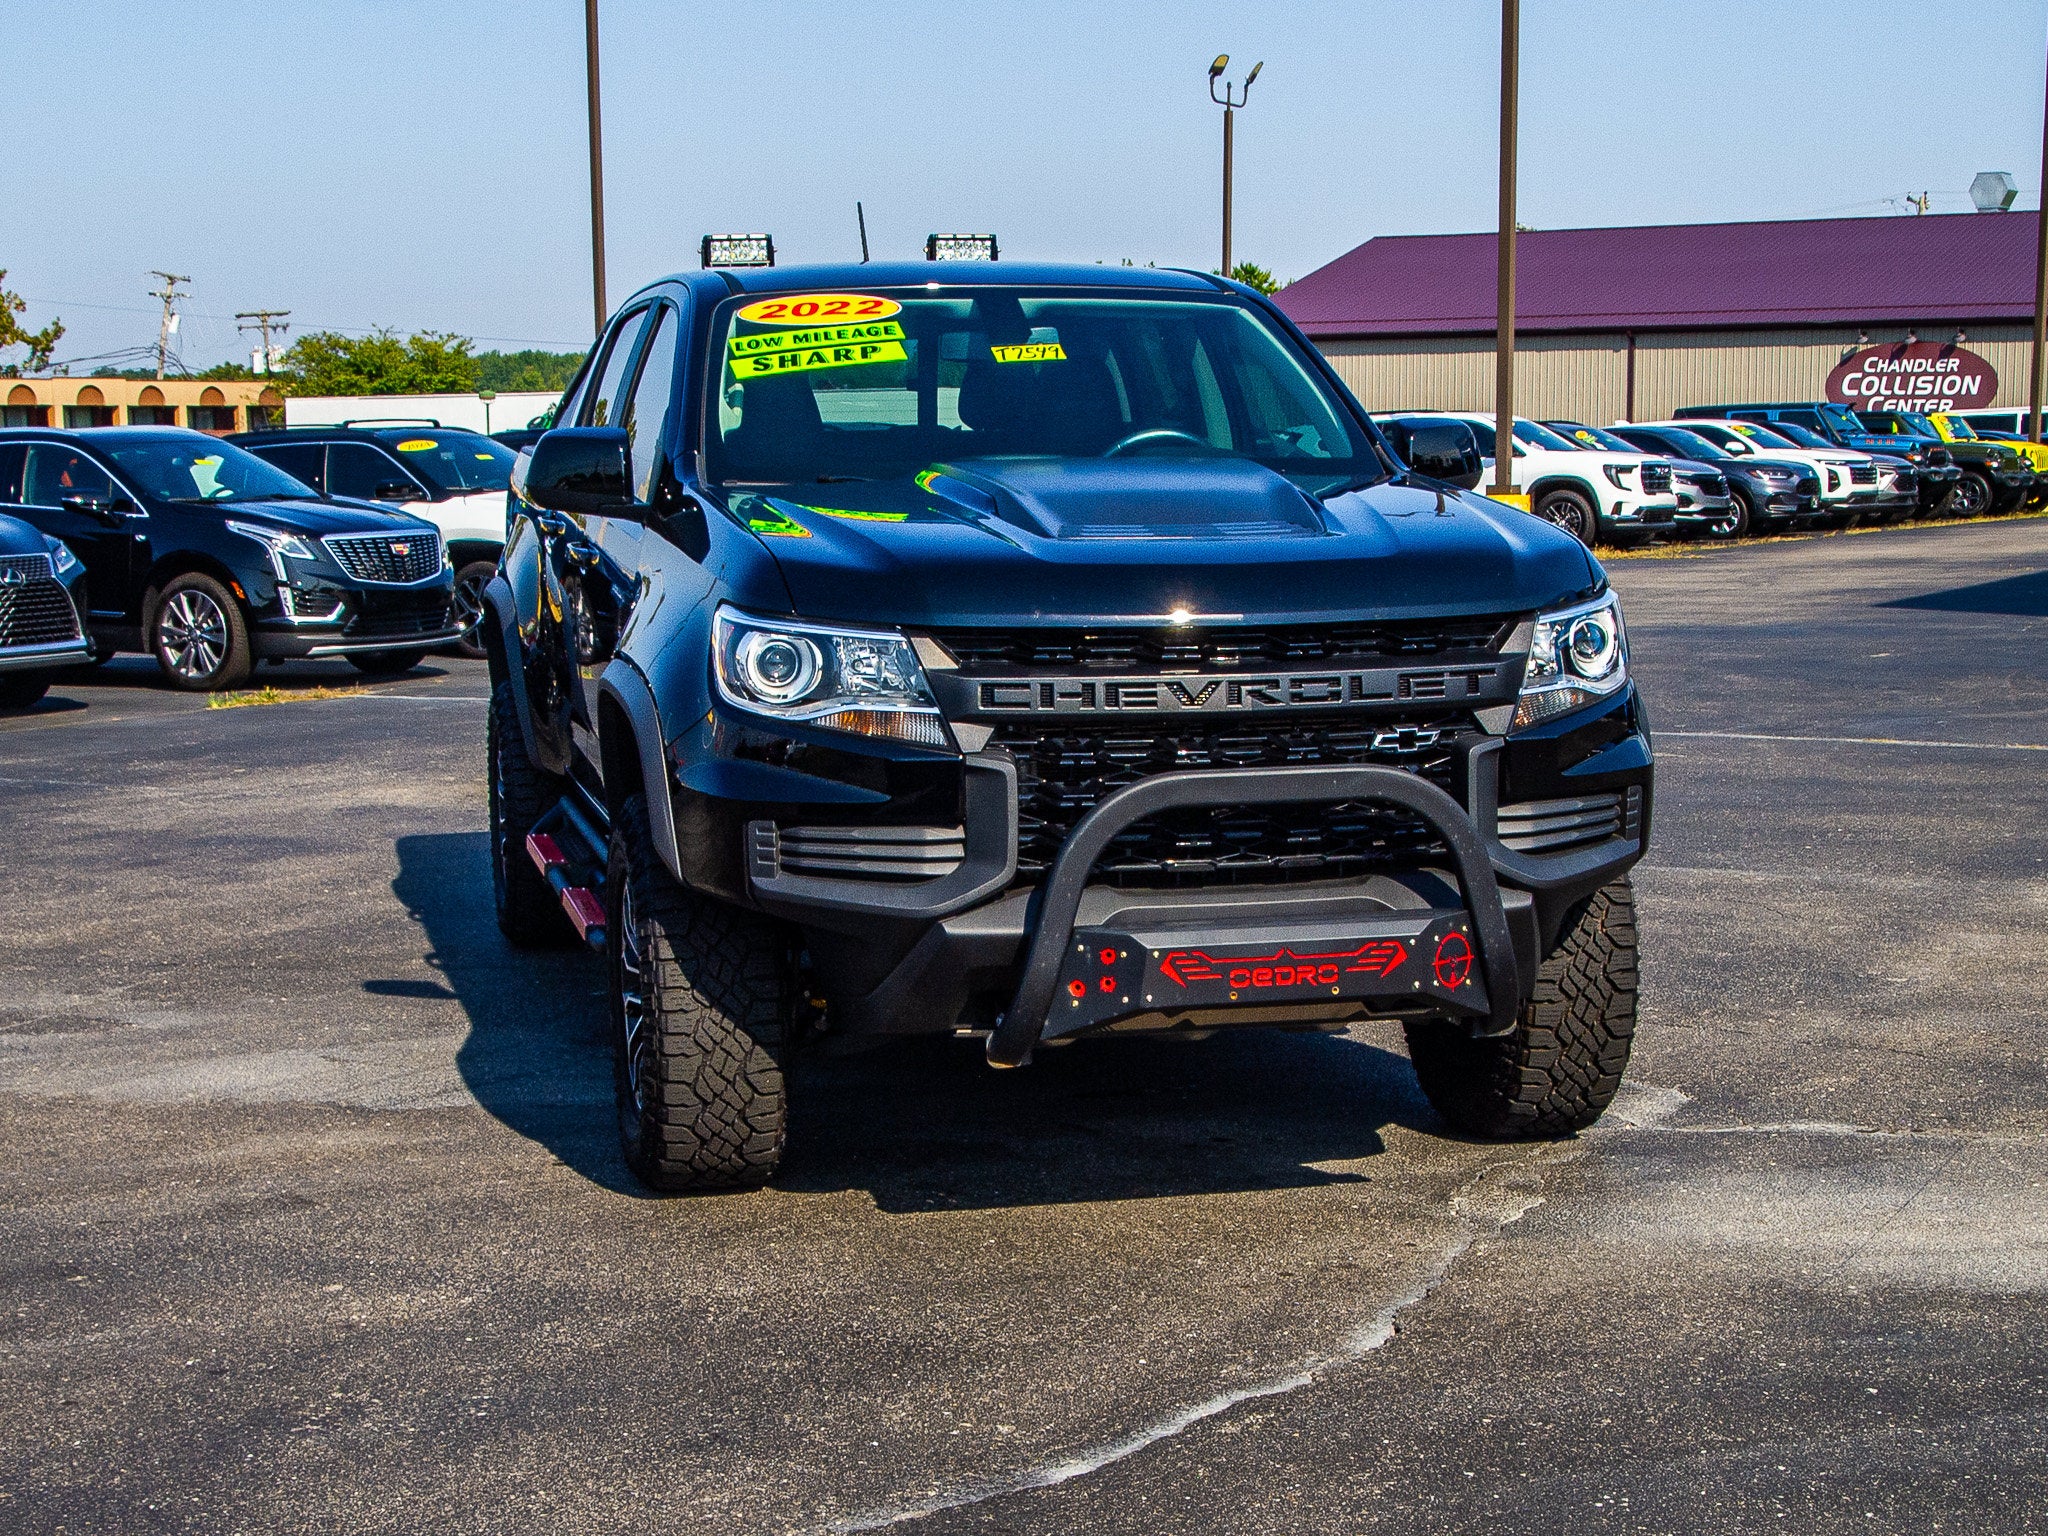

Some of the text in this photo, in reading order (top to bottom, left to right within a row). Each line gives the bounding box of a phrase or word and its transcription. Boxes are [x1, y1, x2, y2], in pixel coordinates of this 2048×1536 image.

[759, 301, 884, 319] 2022
[735, 325, 897, 352] LOW MILEAGE
[753, 345, 882, 372] SHARP
[1864, 356, 1960, 373] CHANDLER
[1841, 372, 1982, 396] COLLISION
[1867, 397, 1954, 412] CENTER
[977, 668, 1498, 711] CHEVROLET
